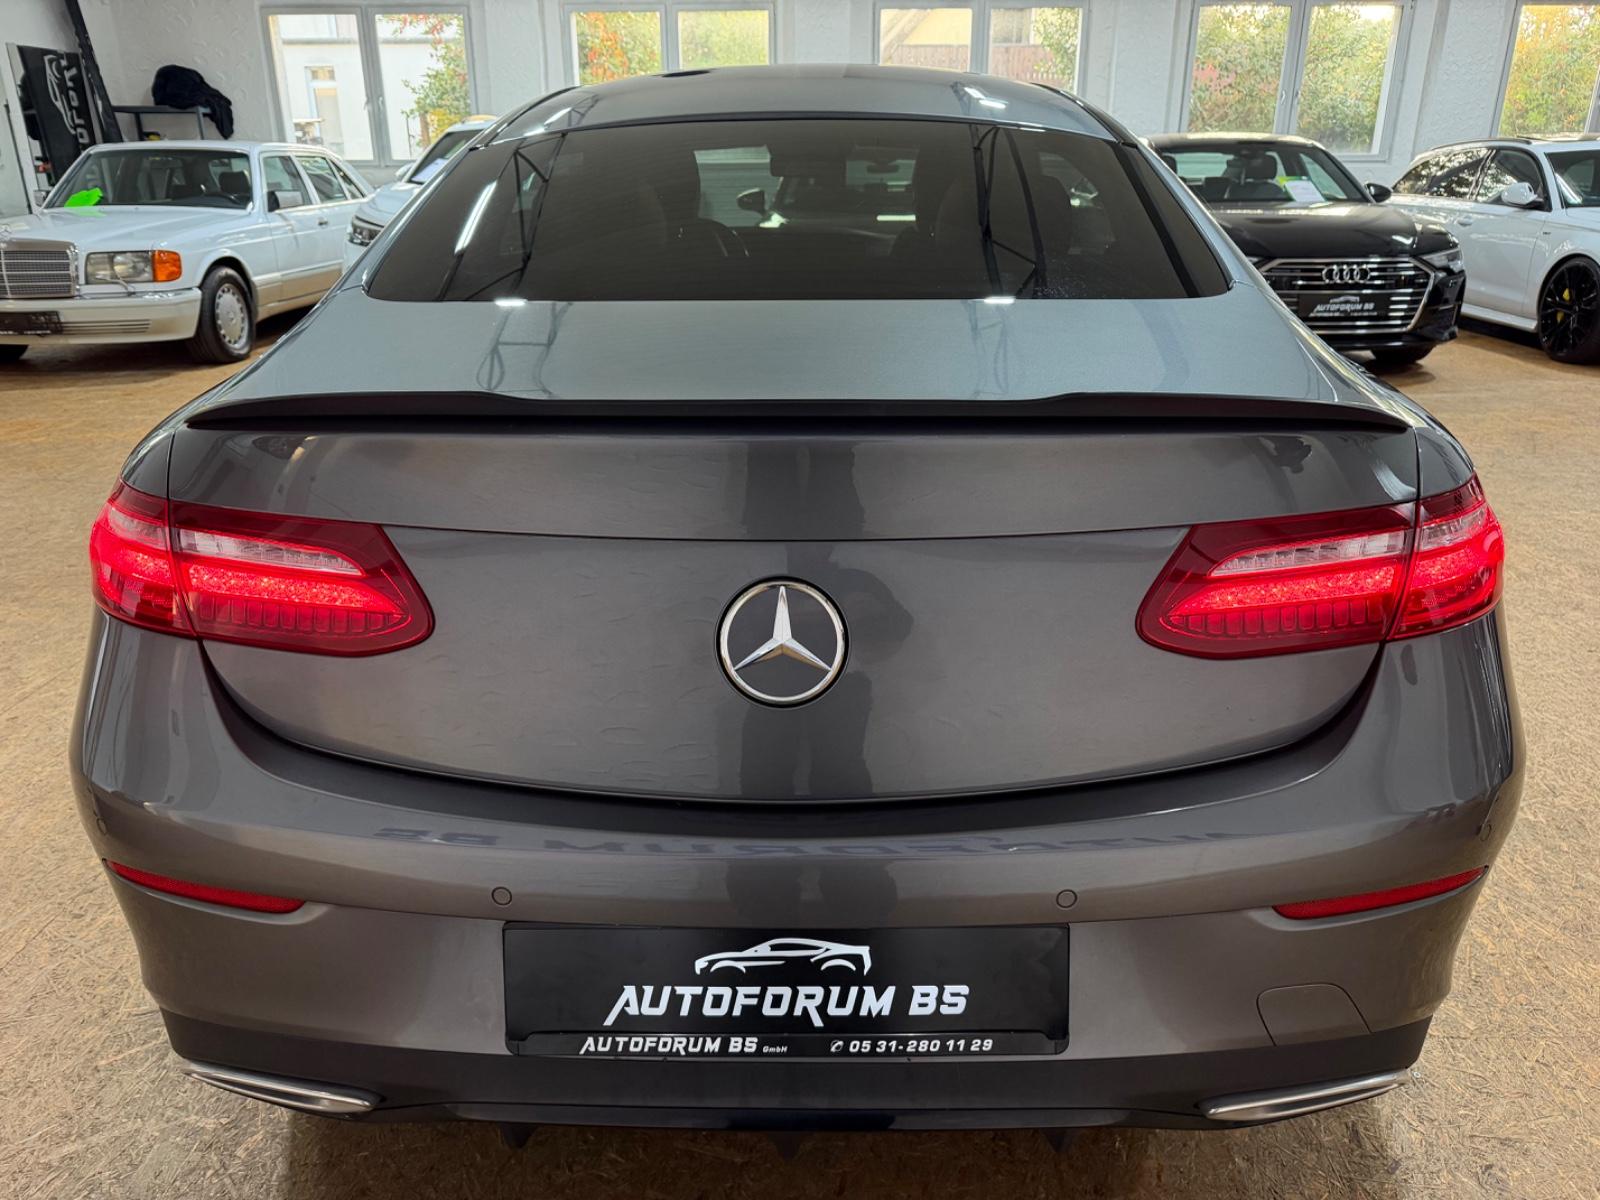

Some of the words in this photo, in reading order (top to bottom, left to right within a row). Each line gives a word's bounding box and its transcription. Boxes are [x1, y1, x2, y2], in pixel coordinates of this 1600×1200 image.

[603, 985, 896, 1027] AUTOFORUM
[909, 985, 970, 1016] BS
[579, 1037, 722, 1056] AUTOFORUM
[728, 1037, 758, 1053] BS
[762, 1046, 788, 1054] GmbH
[849, 1040, 872, 1053] 05
[946, 1039, 966, 1052] 11
[970, 1039, 993, 1051] 29
